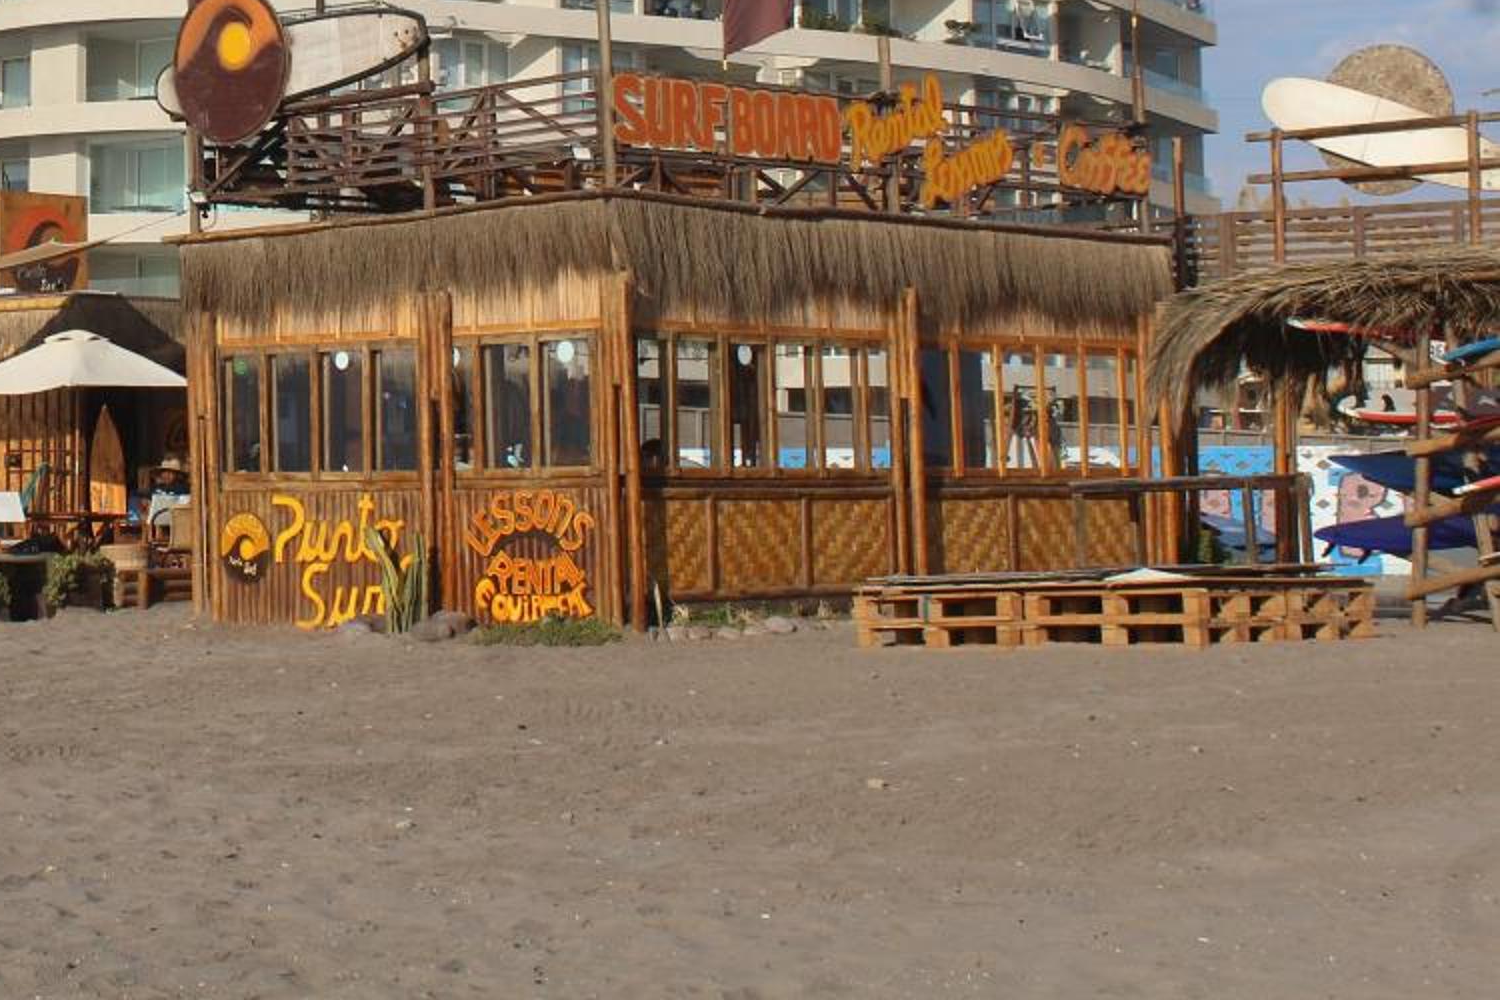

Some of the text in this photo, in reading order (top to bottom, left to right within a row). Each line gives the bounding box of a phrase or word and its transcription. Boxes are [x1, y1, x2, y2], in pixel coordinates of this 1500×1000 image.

[845, 71, 946, 173] Rental
[1058, 121, 1153, 195] Coffee
[466, 488, 595, 557] LESSONS
